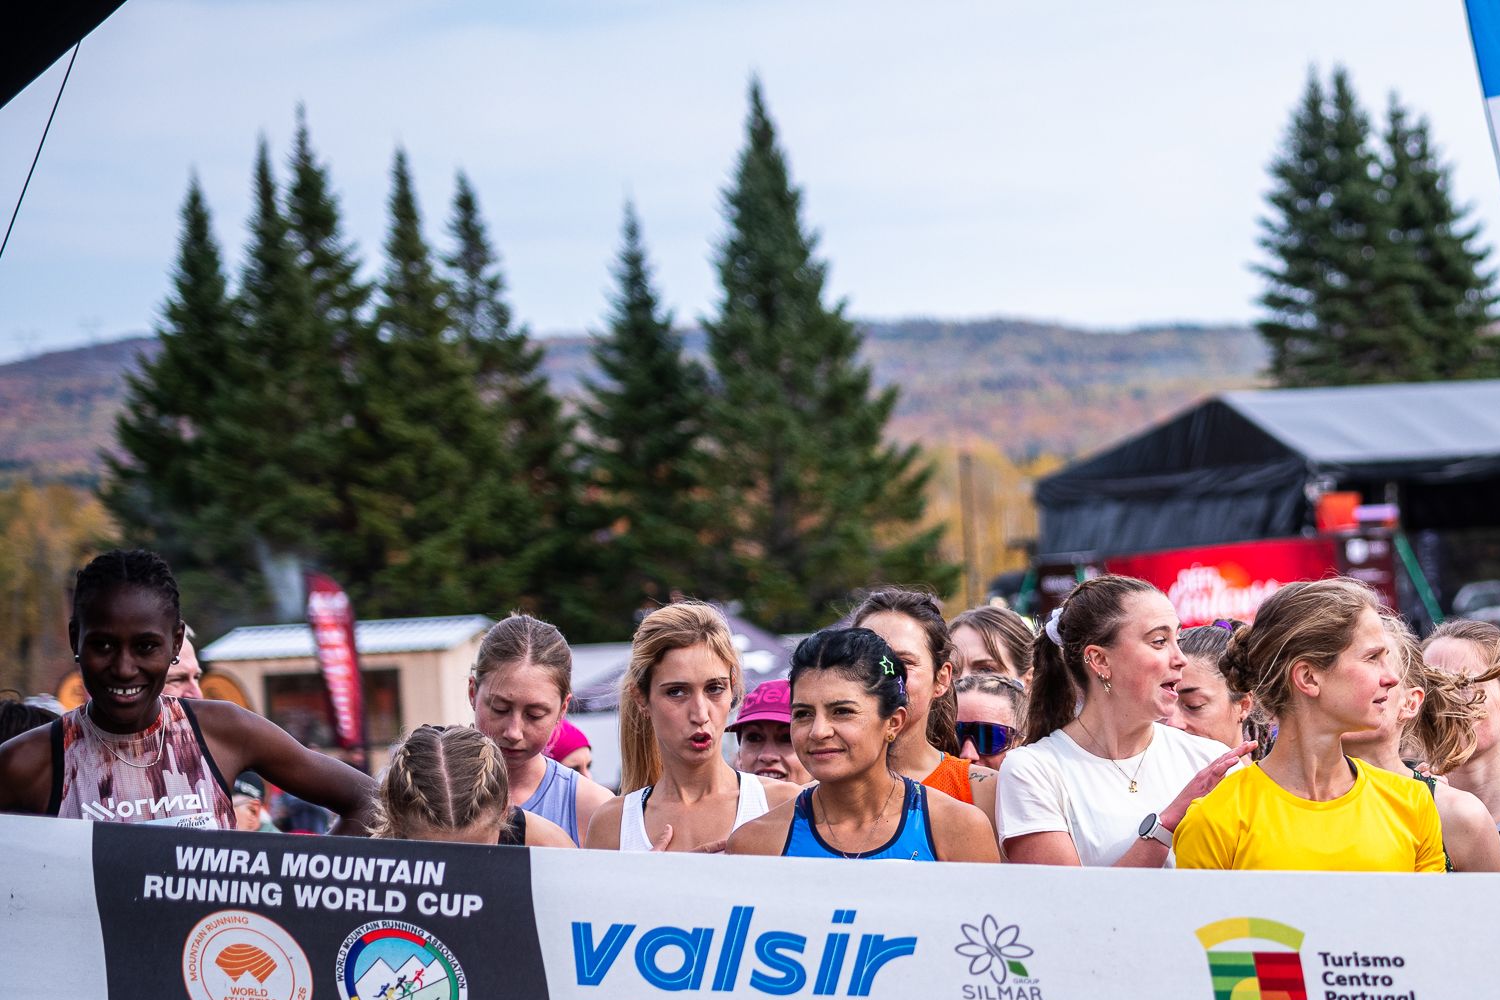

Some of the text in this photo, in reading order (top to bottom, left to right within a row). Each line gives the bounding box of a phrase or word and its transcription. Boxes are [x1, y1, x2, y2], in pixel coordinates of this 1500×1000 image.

[175, 846, 446, 886] WMRA MOUNTAIN
[143, 875, 484, 918] RUNNING WORLD CUP
[189, 916, 249, 981] MOUNTAIN RUNNING
[343, 921, 380, 948] MOUNTAIN
[381, 920, 425, 937] RUNNING
[426, 935, 466, 989] ASSOCIATION
[571, 905, 918, 997] valsir
[1318, 951, 1405, 968] Turismo
[230, 986, 268, 997] WORLD
[962, 984, 1043, 1000] SILMAR
[1322, 971, 1393, 987] Centro
